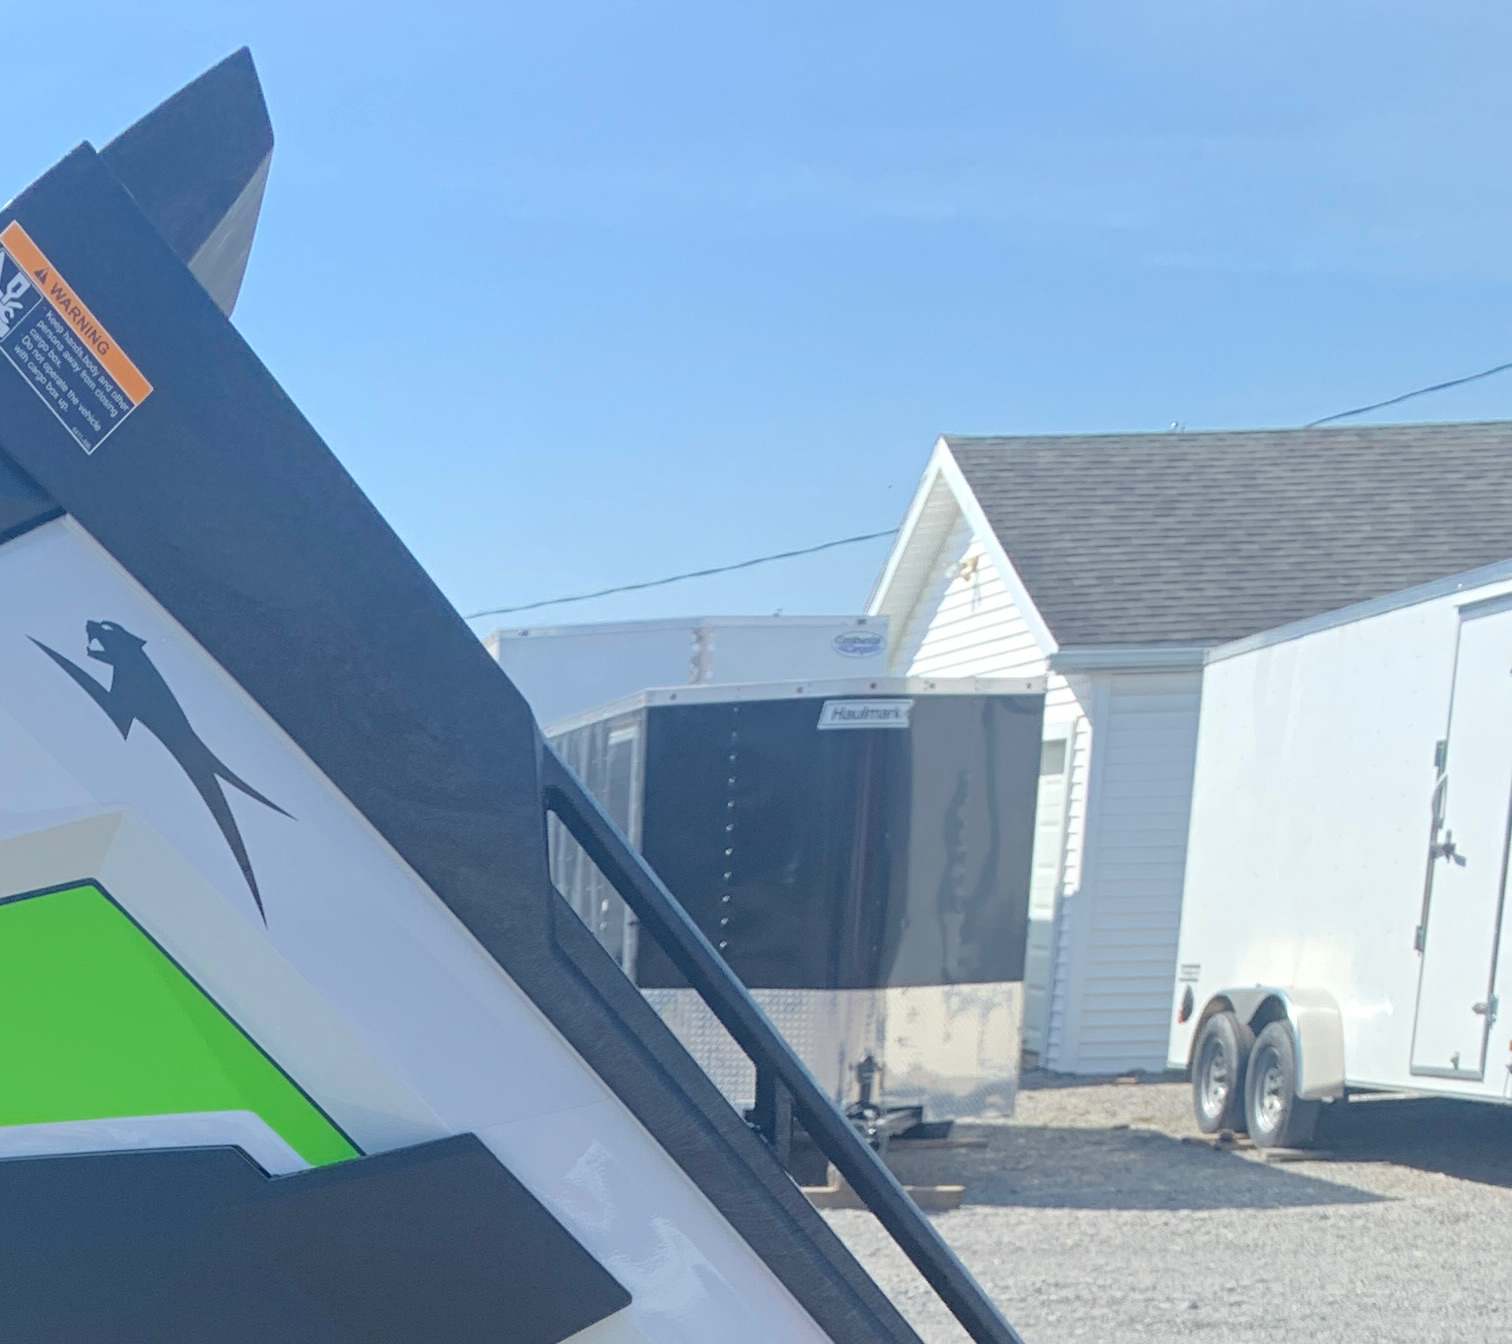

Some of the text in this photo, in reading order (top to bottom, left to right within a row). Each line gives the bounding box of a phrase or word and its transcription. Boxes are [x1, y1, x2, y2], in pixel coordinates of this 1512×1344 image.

[29, 328, 49, 352] cargo
[50, 282, 109, 356] WARNING
[13, 345, 28, 363] with
[27, 361, 46, 384] cargo
[45, 381, 59, 399] box
[21, 335, 33, 350] Do
[31, 349, 44, 364] not
[42, 362, 68, 392] operate
[66, 390, 79, 405] the
[78, 404, 101, 432] vehicle
[35, 320, 118, 418] persons away from closing
[45, 310, 64, 334] Keep
[97, 376, 113, 392] and
[110, 391, 129, 411] other
[830, 707, 905, 720] Haulmark
